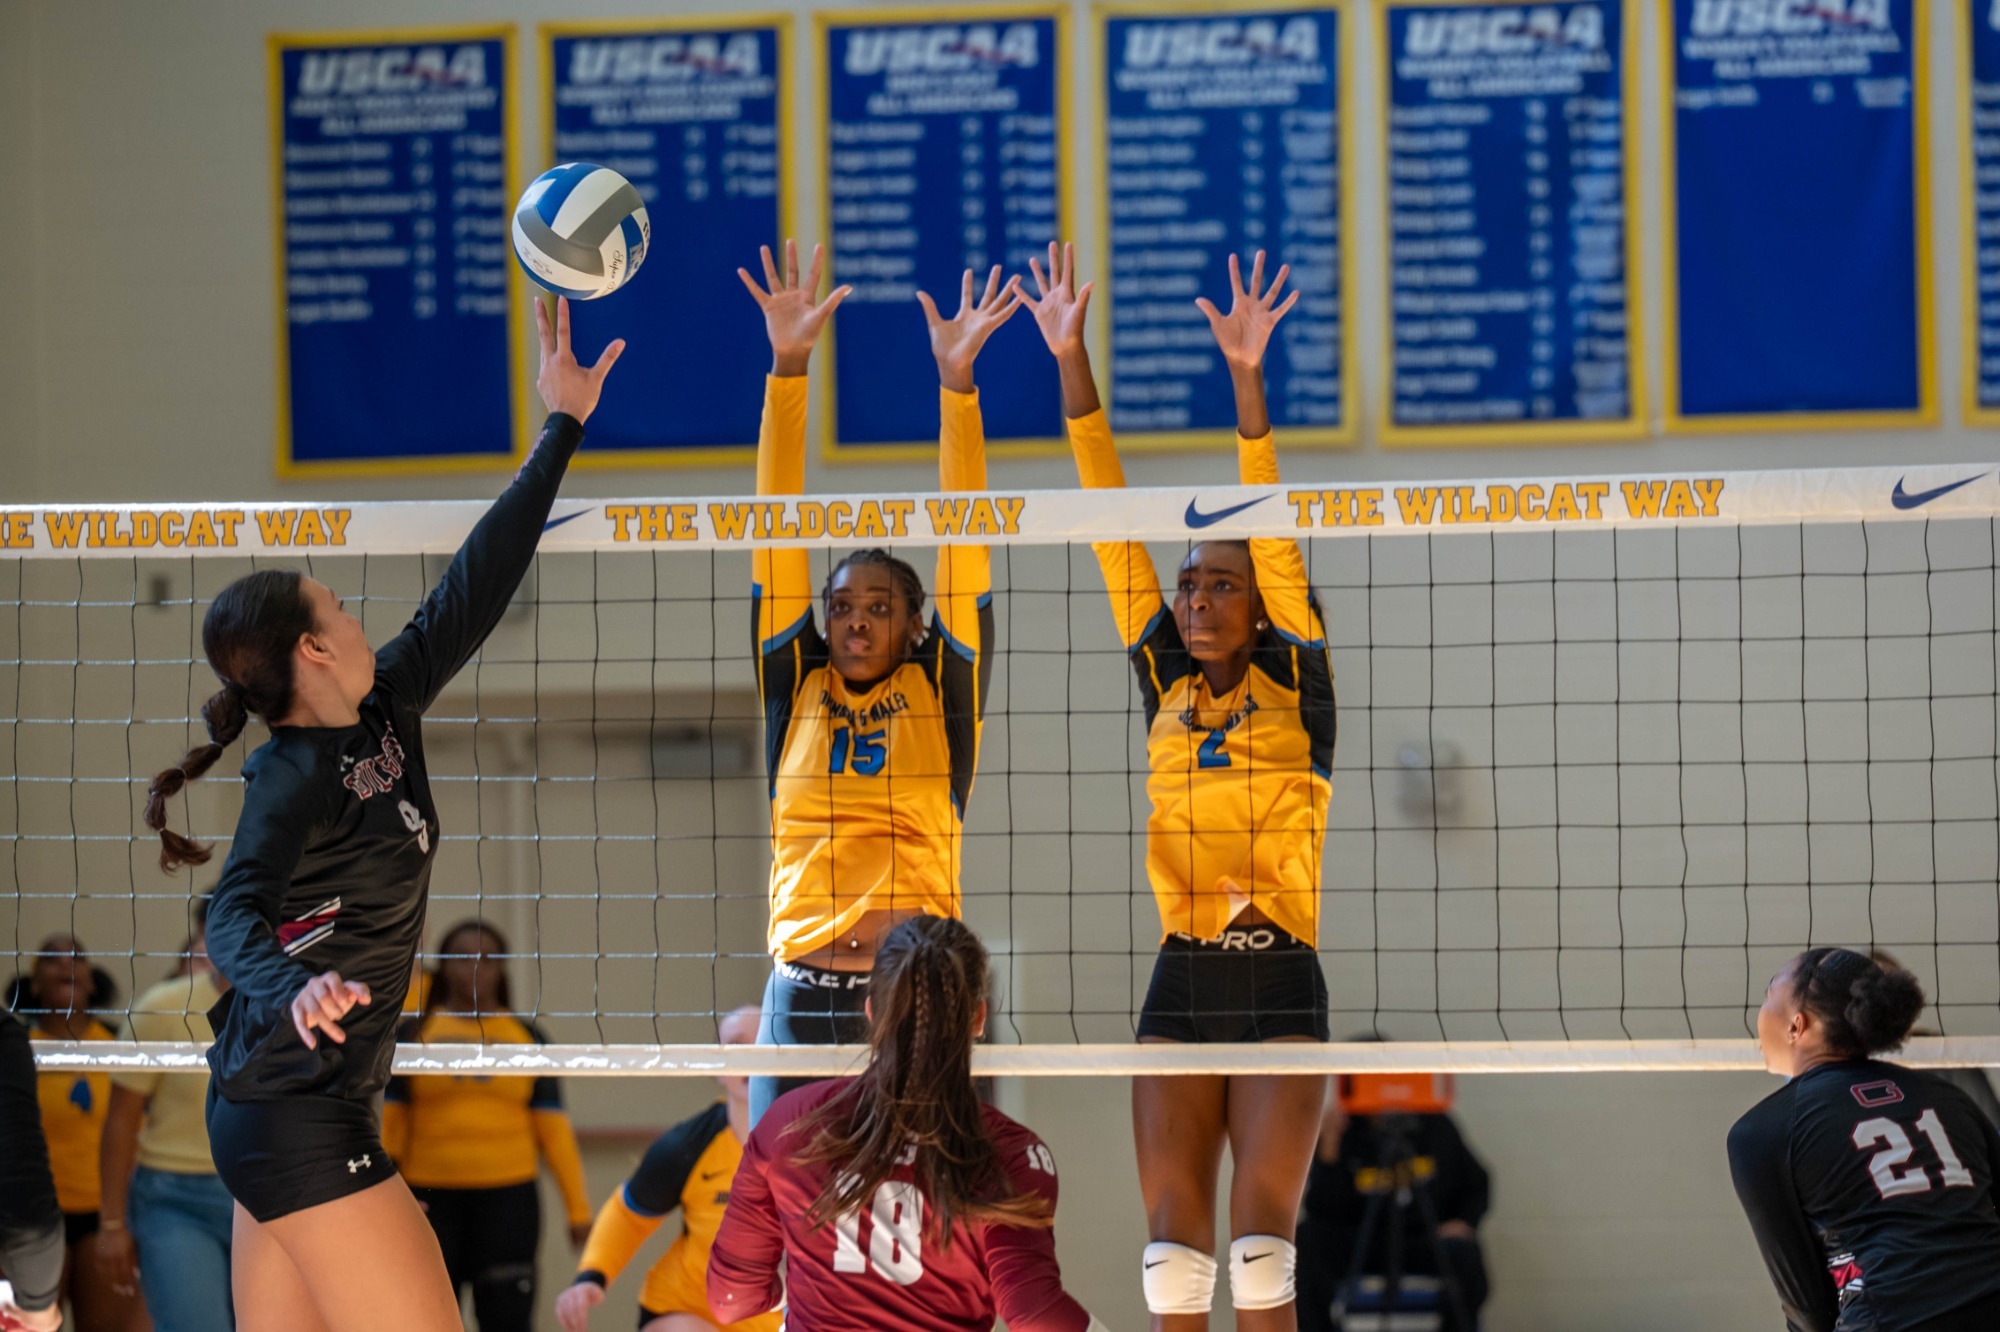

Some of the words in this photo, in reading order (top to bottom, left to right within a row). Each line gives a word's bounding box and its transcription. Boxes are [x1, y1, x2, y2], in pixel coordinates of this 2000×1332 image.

[605, 504, 698, 541] THE
[708, 500, 914, 540] WILDCAT
[925, 498, 1025, 536] WAY
[1288, 488, 1385, 528] THE
[1394, 482, 1609, 525] WILDCAT
[1620, 479, 1724, 518] WAY
[44, 510, 244, 548] WILDCAT
[255, 509, 351, 546] WAY
[829, 726, 887, 776] 15
[1197, 731, 1231, 769] 2
[1026, 1143, 1056, 1177] 18
[1852, 1108, 1976, 1200] 21
[833, 1170, 924, 1287] 18
